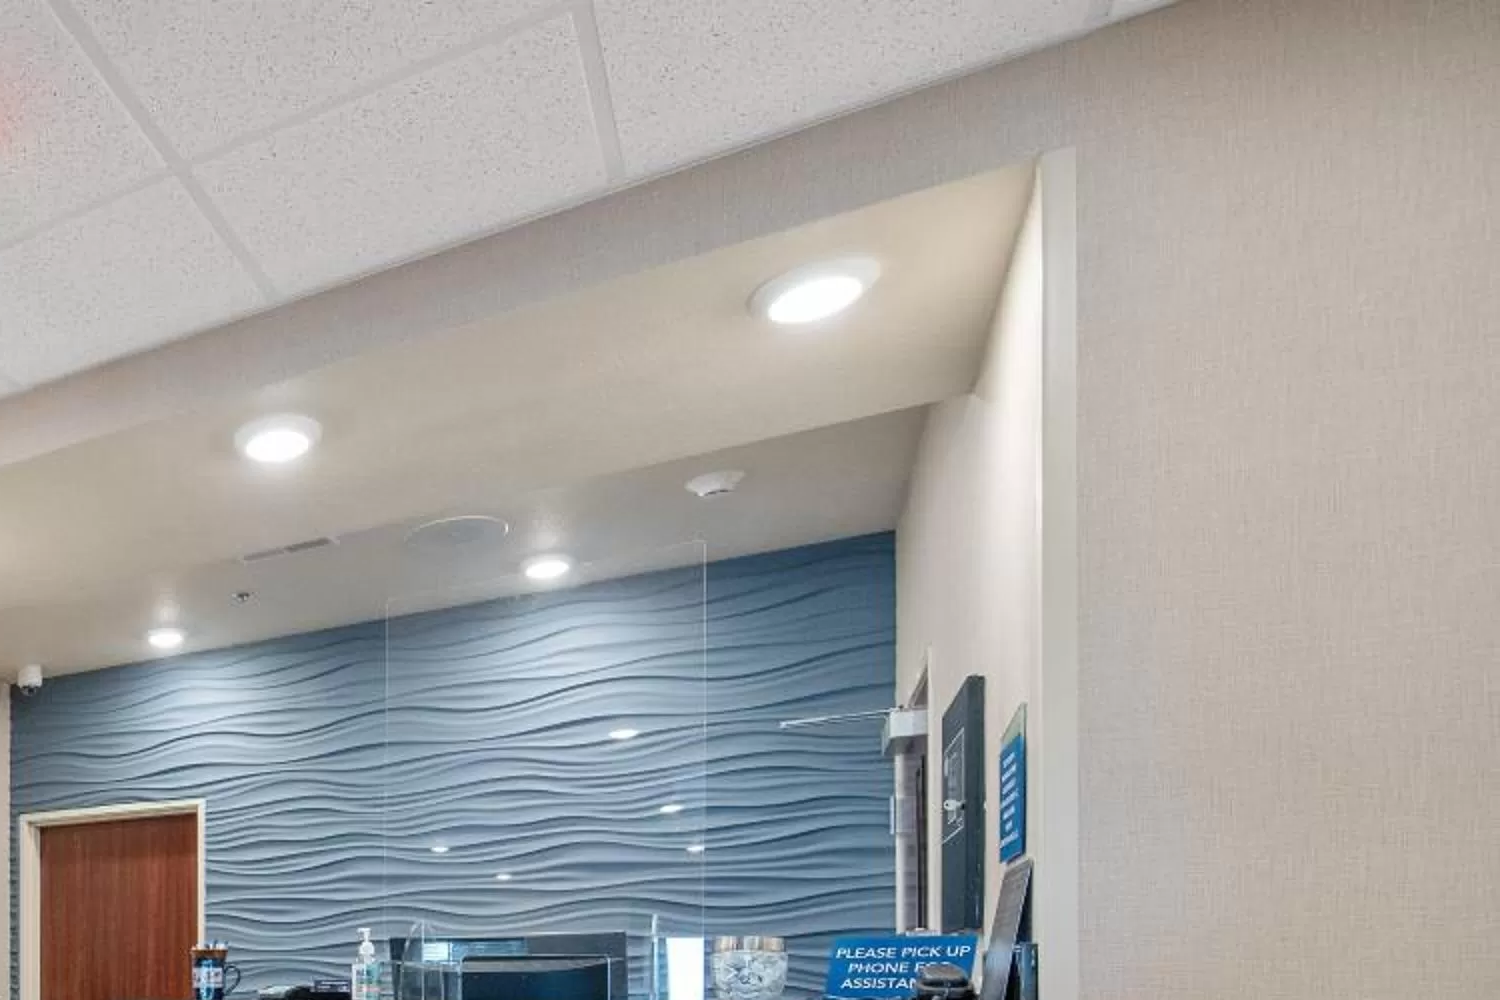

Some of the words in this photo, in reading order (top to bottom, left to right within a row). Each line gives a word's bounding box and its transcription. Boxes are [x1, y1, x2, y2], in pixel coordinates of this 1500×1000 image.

[835, 946, 897, 959] PLEASE
[901, 945, 942, 958] PICK
[947, 945, 972, 958] UP
[847, 961, 909, 973] PHONE
